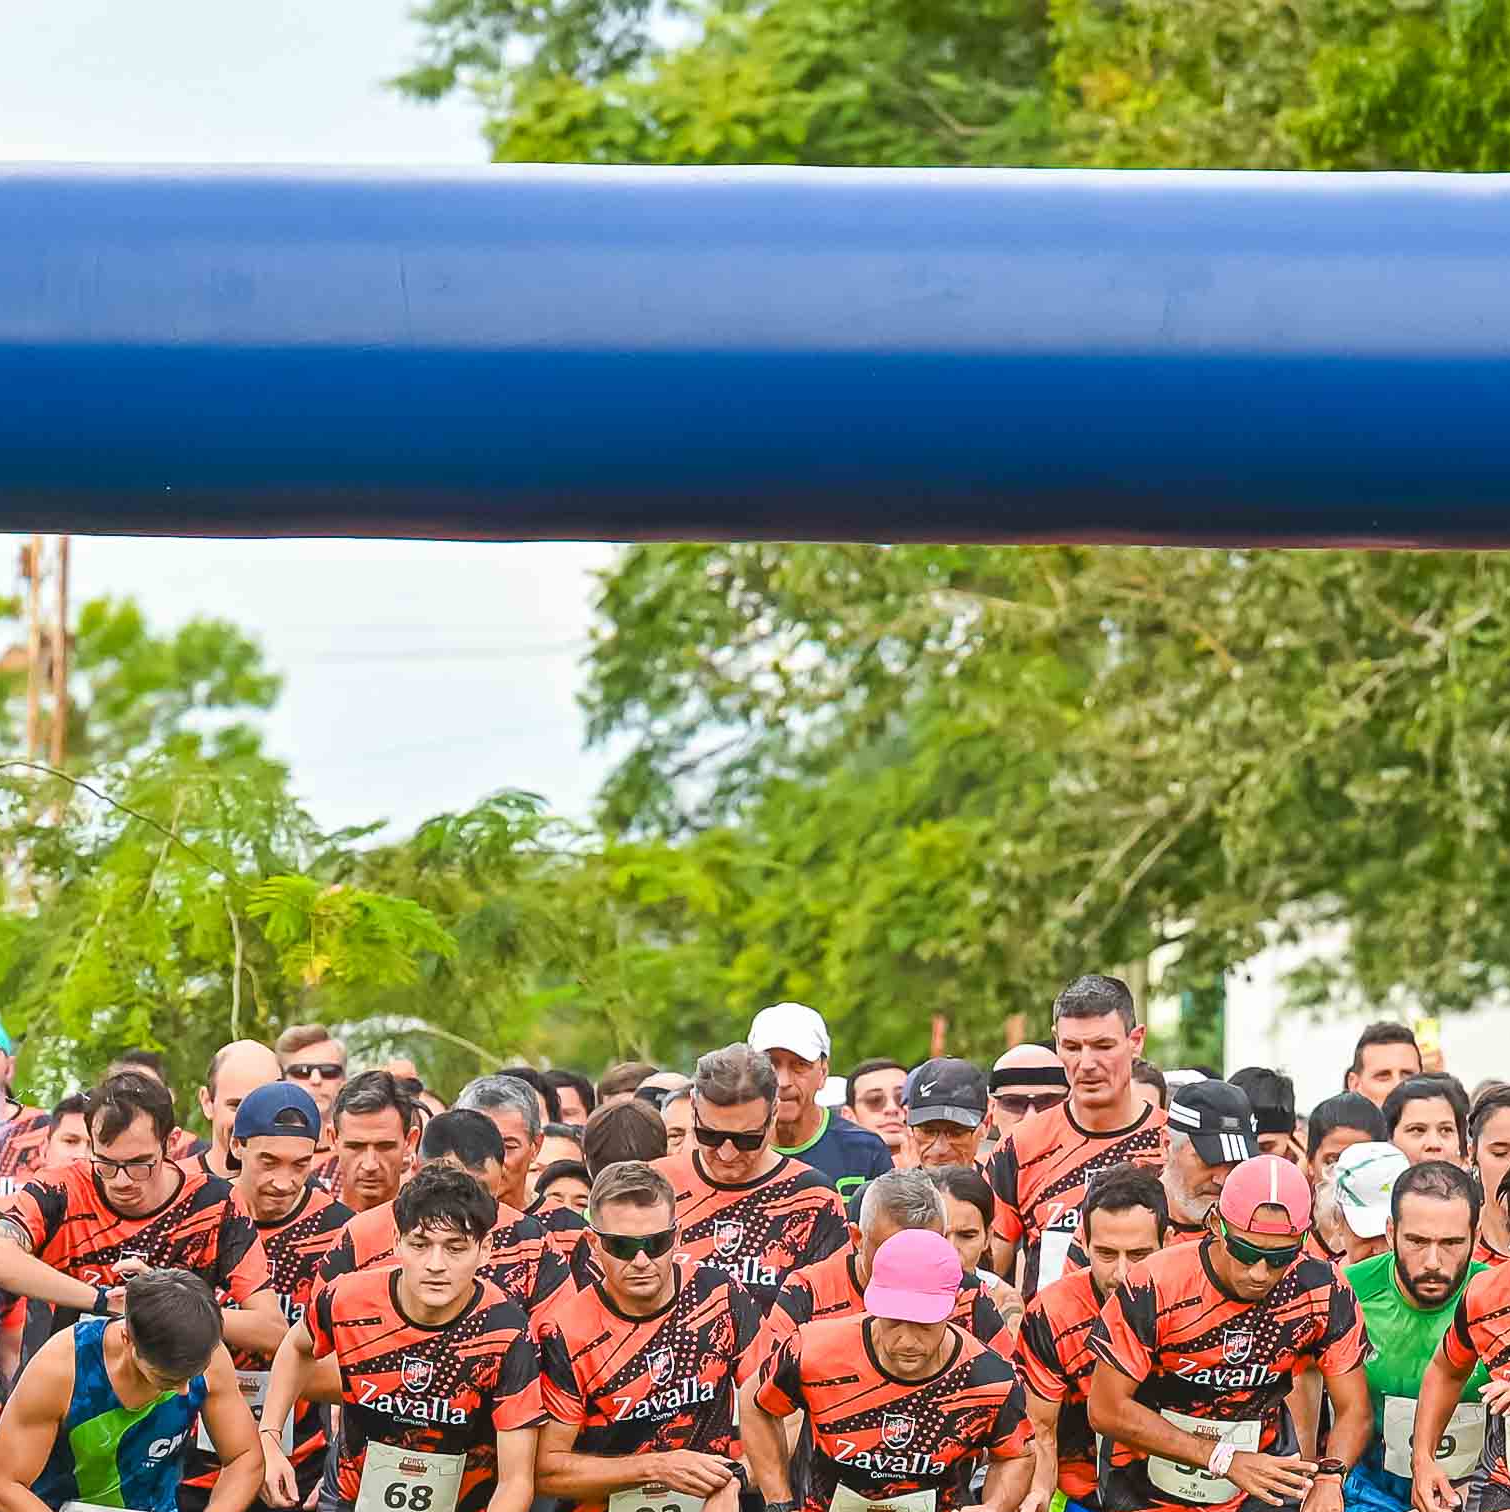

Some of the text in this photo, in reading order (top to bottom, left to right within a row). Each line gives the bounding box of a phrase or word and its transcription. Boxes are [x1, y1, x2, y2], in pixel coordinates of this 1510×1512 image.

[1174, 1357, 1281, 1388] Zavalla
[358, 1379, 467, 1425] Zavalla
[613, 1376, 715, 1421] Zavalla
[834, 1439, 946, 1475] Zavalla
[1409, 1435, 1457, 1459] 9
[384, 1482, 434, 1511] 68
